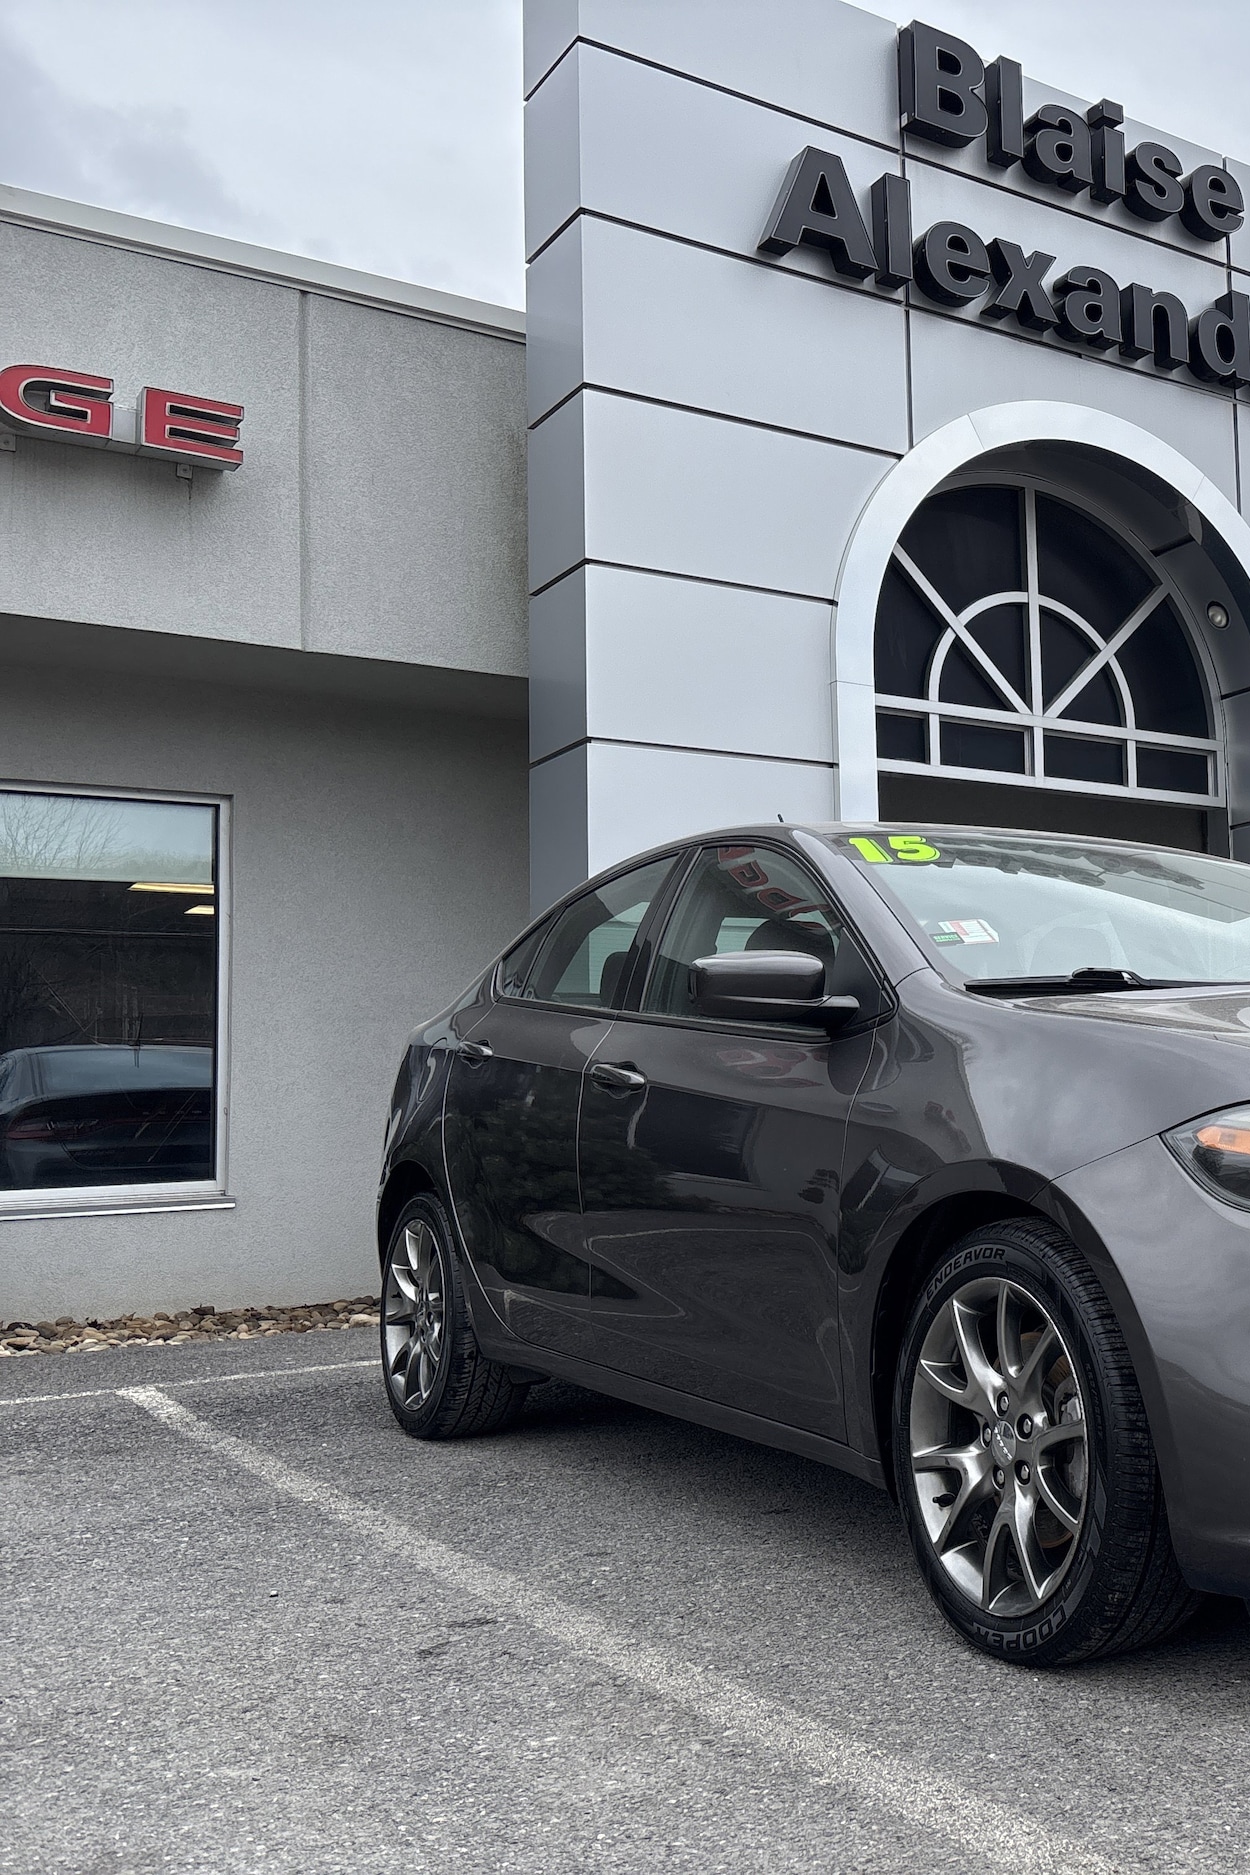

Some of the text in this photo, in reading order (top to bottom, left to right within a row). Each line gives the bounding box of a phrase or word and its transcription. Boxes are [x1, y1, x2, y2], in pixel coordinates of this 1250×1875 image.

[898, 19, 1246, 242] Blaise
[0, 364, 244, 471] GE
[849, 836, 941, 863] 15
[926, 1247, 1006, 1301] ENDEAVOR
[972, 1604, 1067, 1652] COOPER
